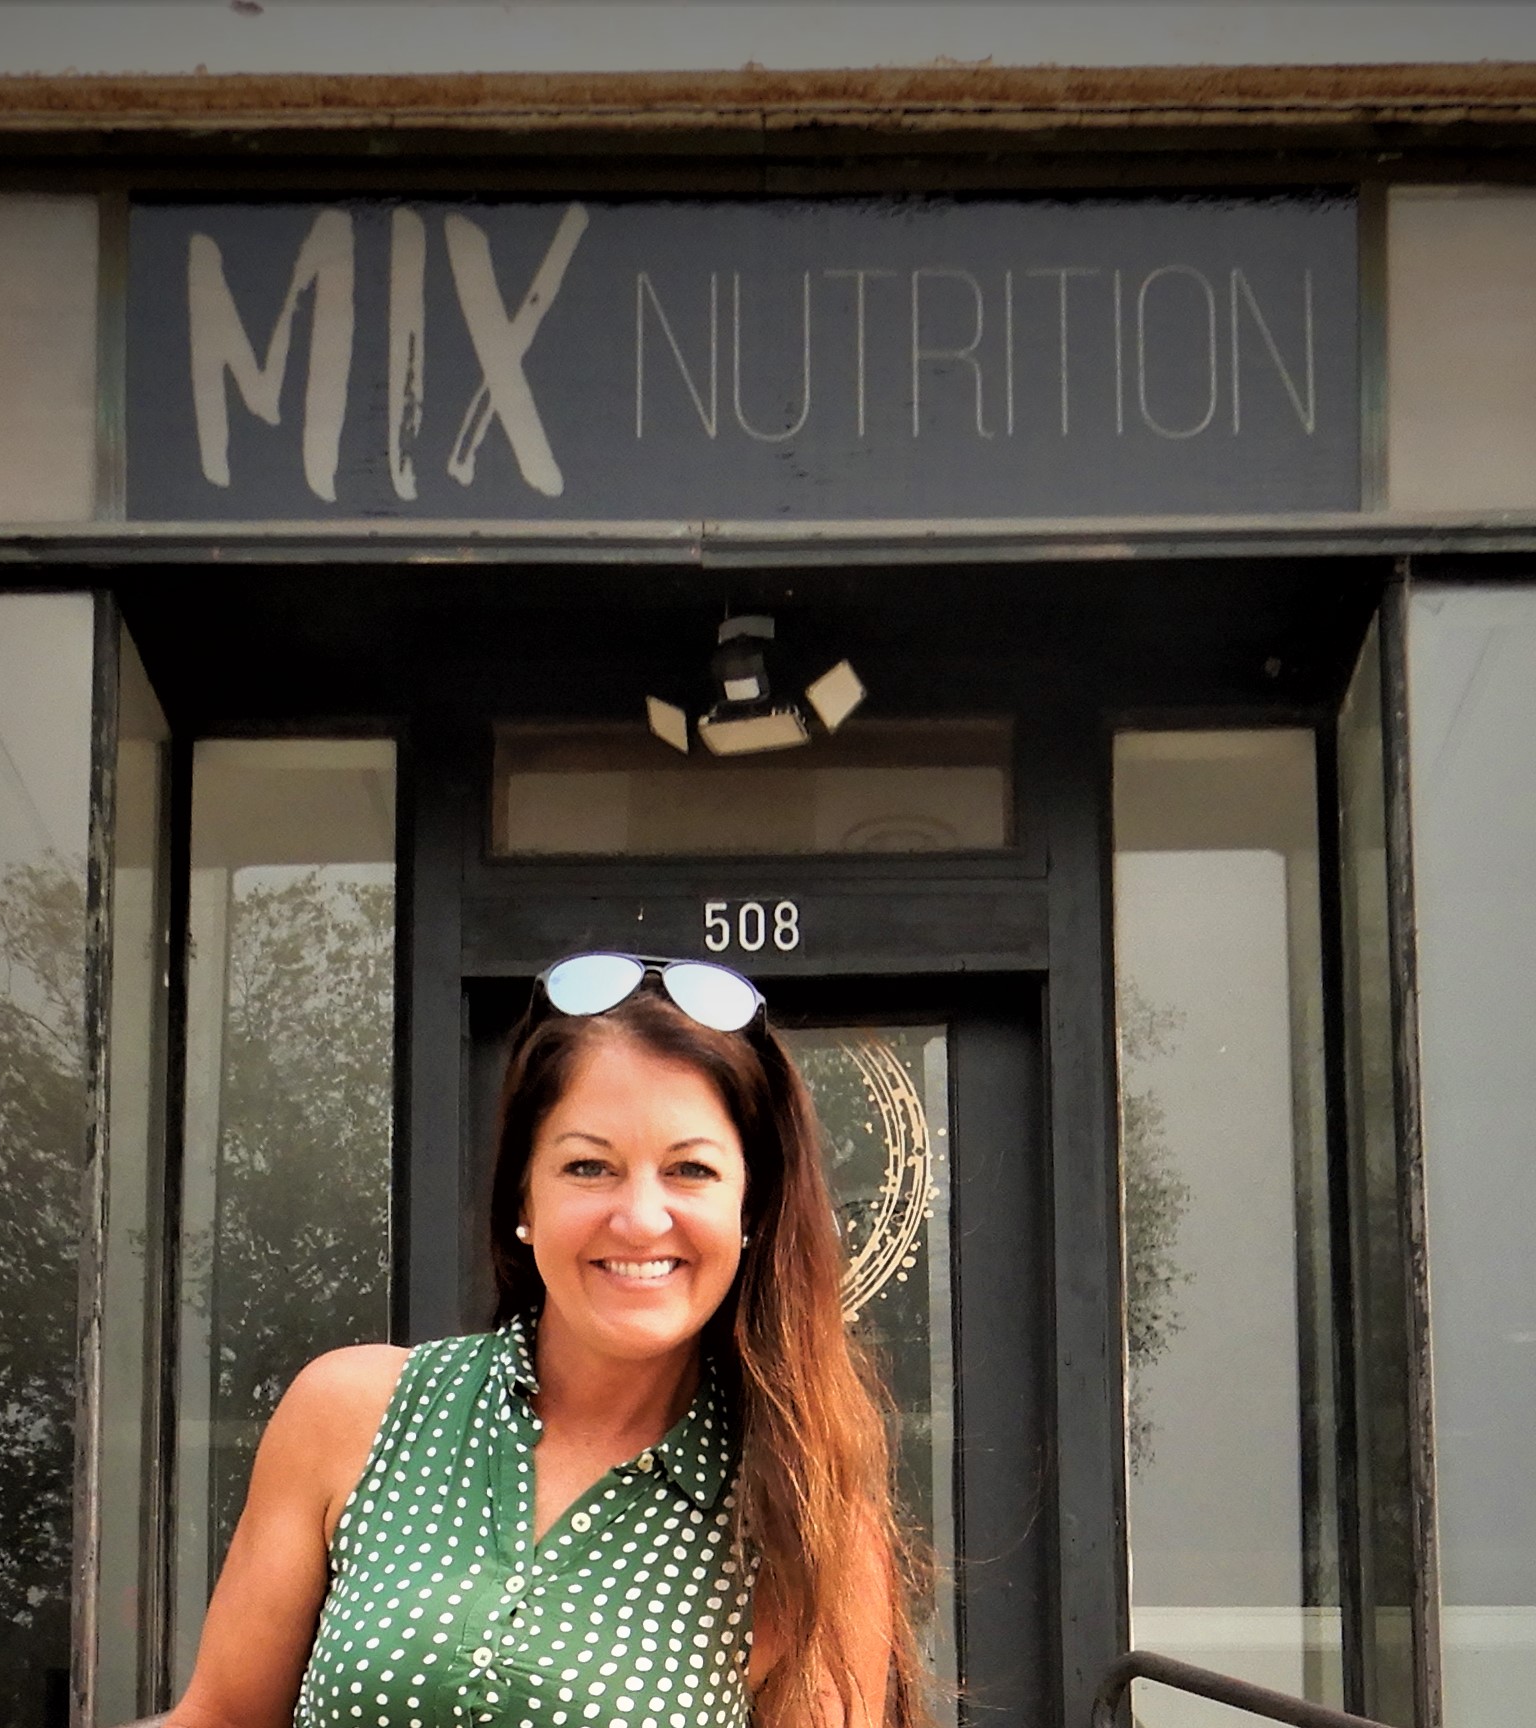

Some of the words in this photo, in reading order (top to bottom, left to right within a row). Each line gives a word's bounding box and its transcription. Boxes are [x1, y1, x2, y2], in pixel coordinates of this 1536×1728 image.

[187, 204, 589, 503] MIX
[635, 264, 1315, 443] NUTRITION
[704, 900, 801, 953] 508
